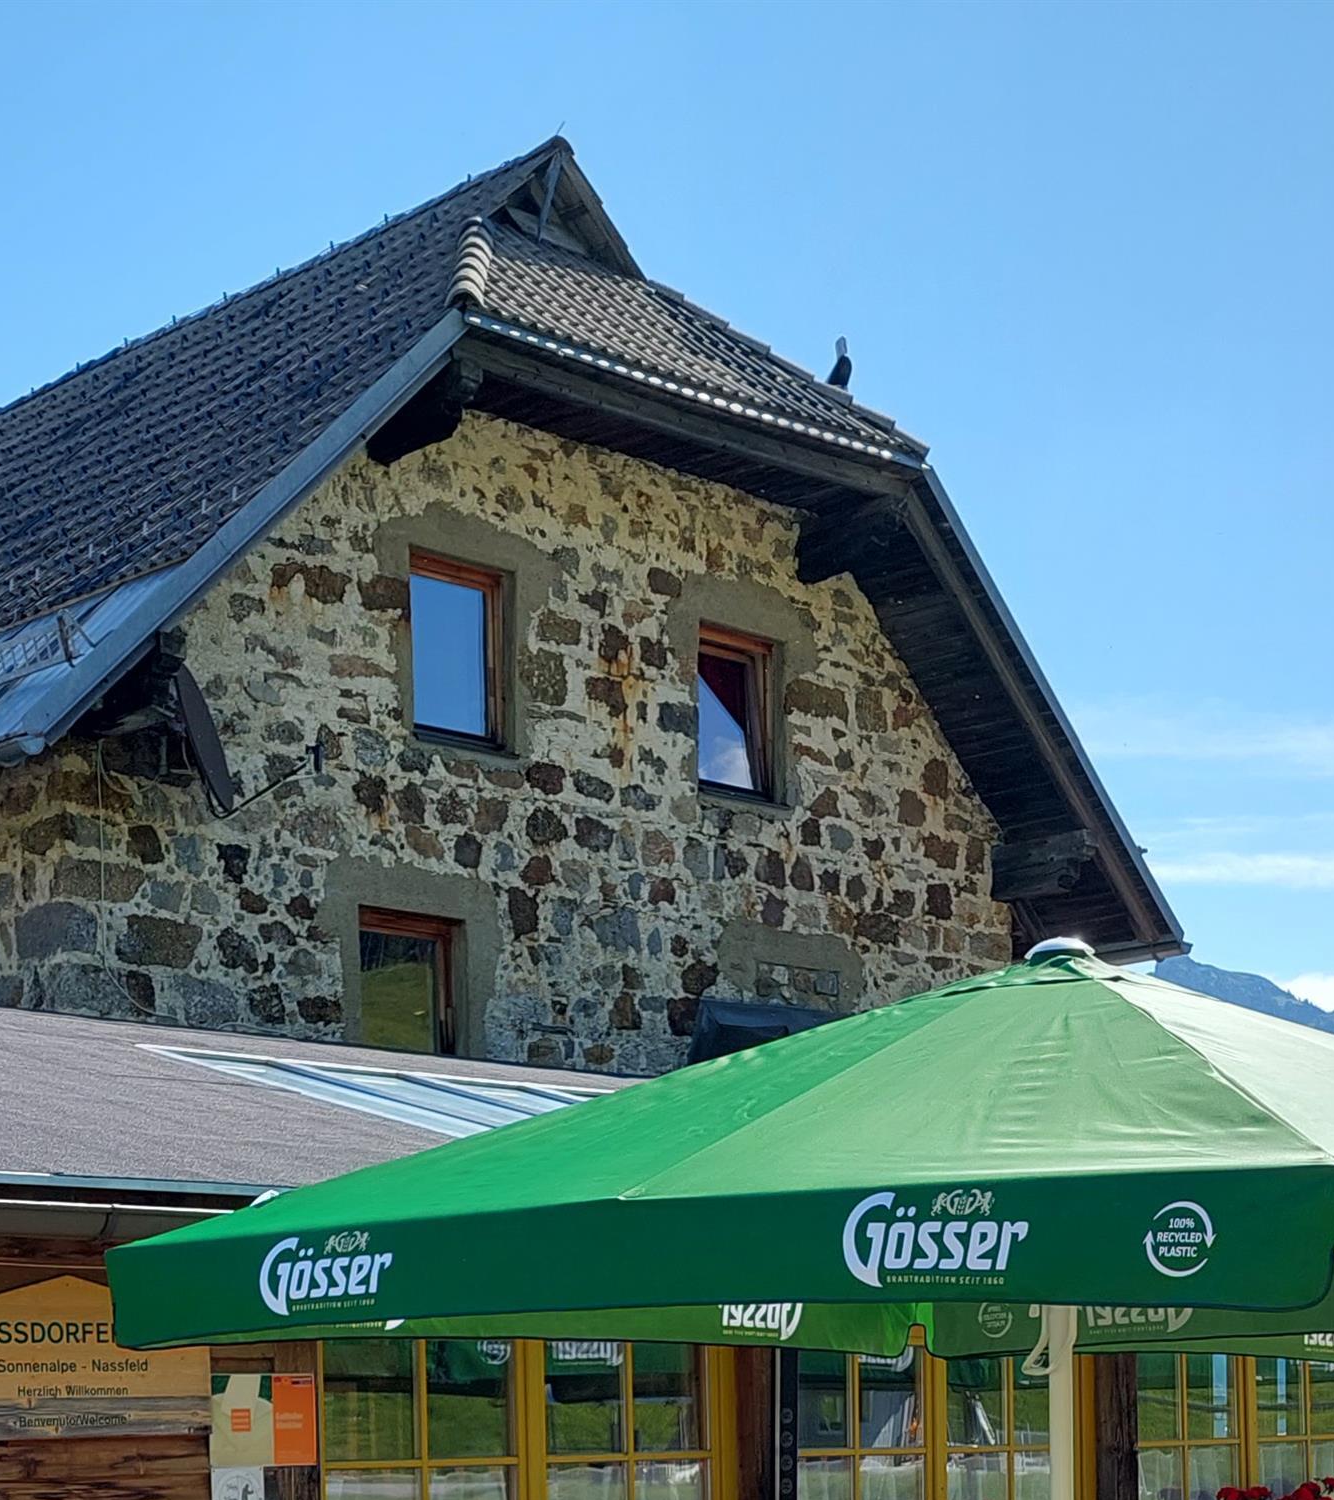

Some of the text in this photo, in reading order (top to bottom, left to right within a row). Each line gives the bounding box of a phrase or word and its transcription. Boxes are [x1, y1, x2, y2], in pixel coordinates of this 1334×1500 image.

[1168, 1218, 1195, 1229] 100%
[843, 1191, 1029, 1288] Gösser
[1156, 1232, 1203, 1243] RECYCLED
[1158, 1246, 1198, 1257] PLASTIC
[259, 1236, 393, 1316] Gösser
[886, 1275, 956, 1284] BRAUTRADITION
[959, 1276, 980, 1285] SEIT
[91, 1359, 149, 1373] Nassfeld
[17, 1385, 129, 1397] Herzlich Willkommen
